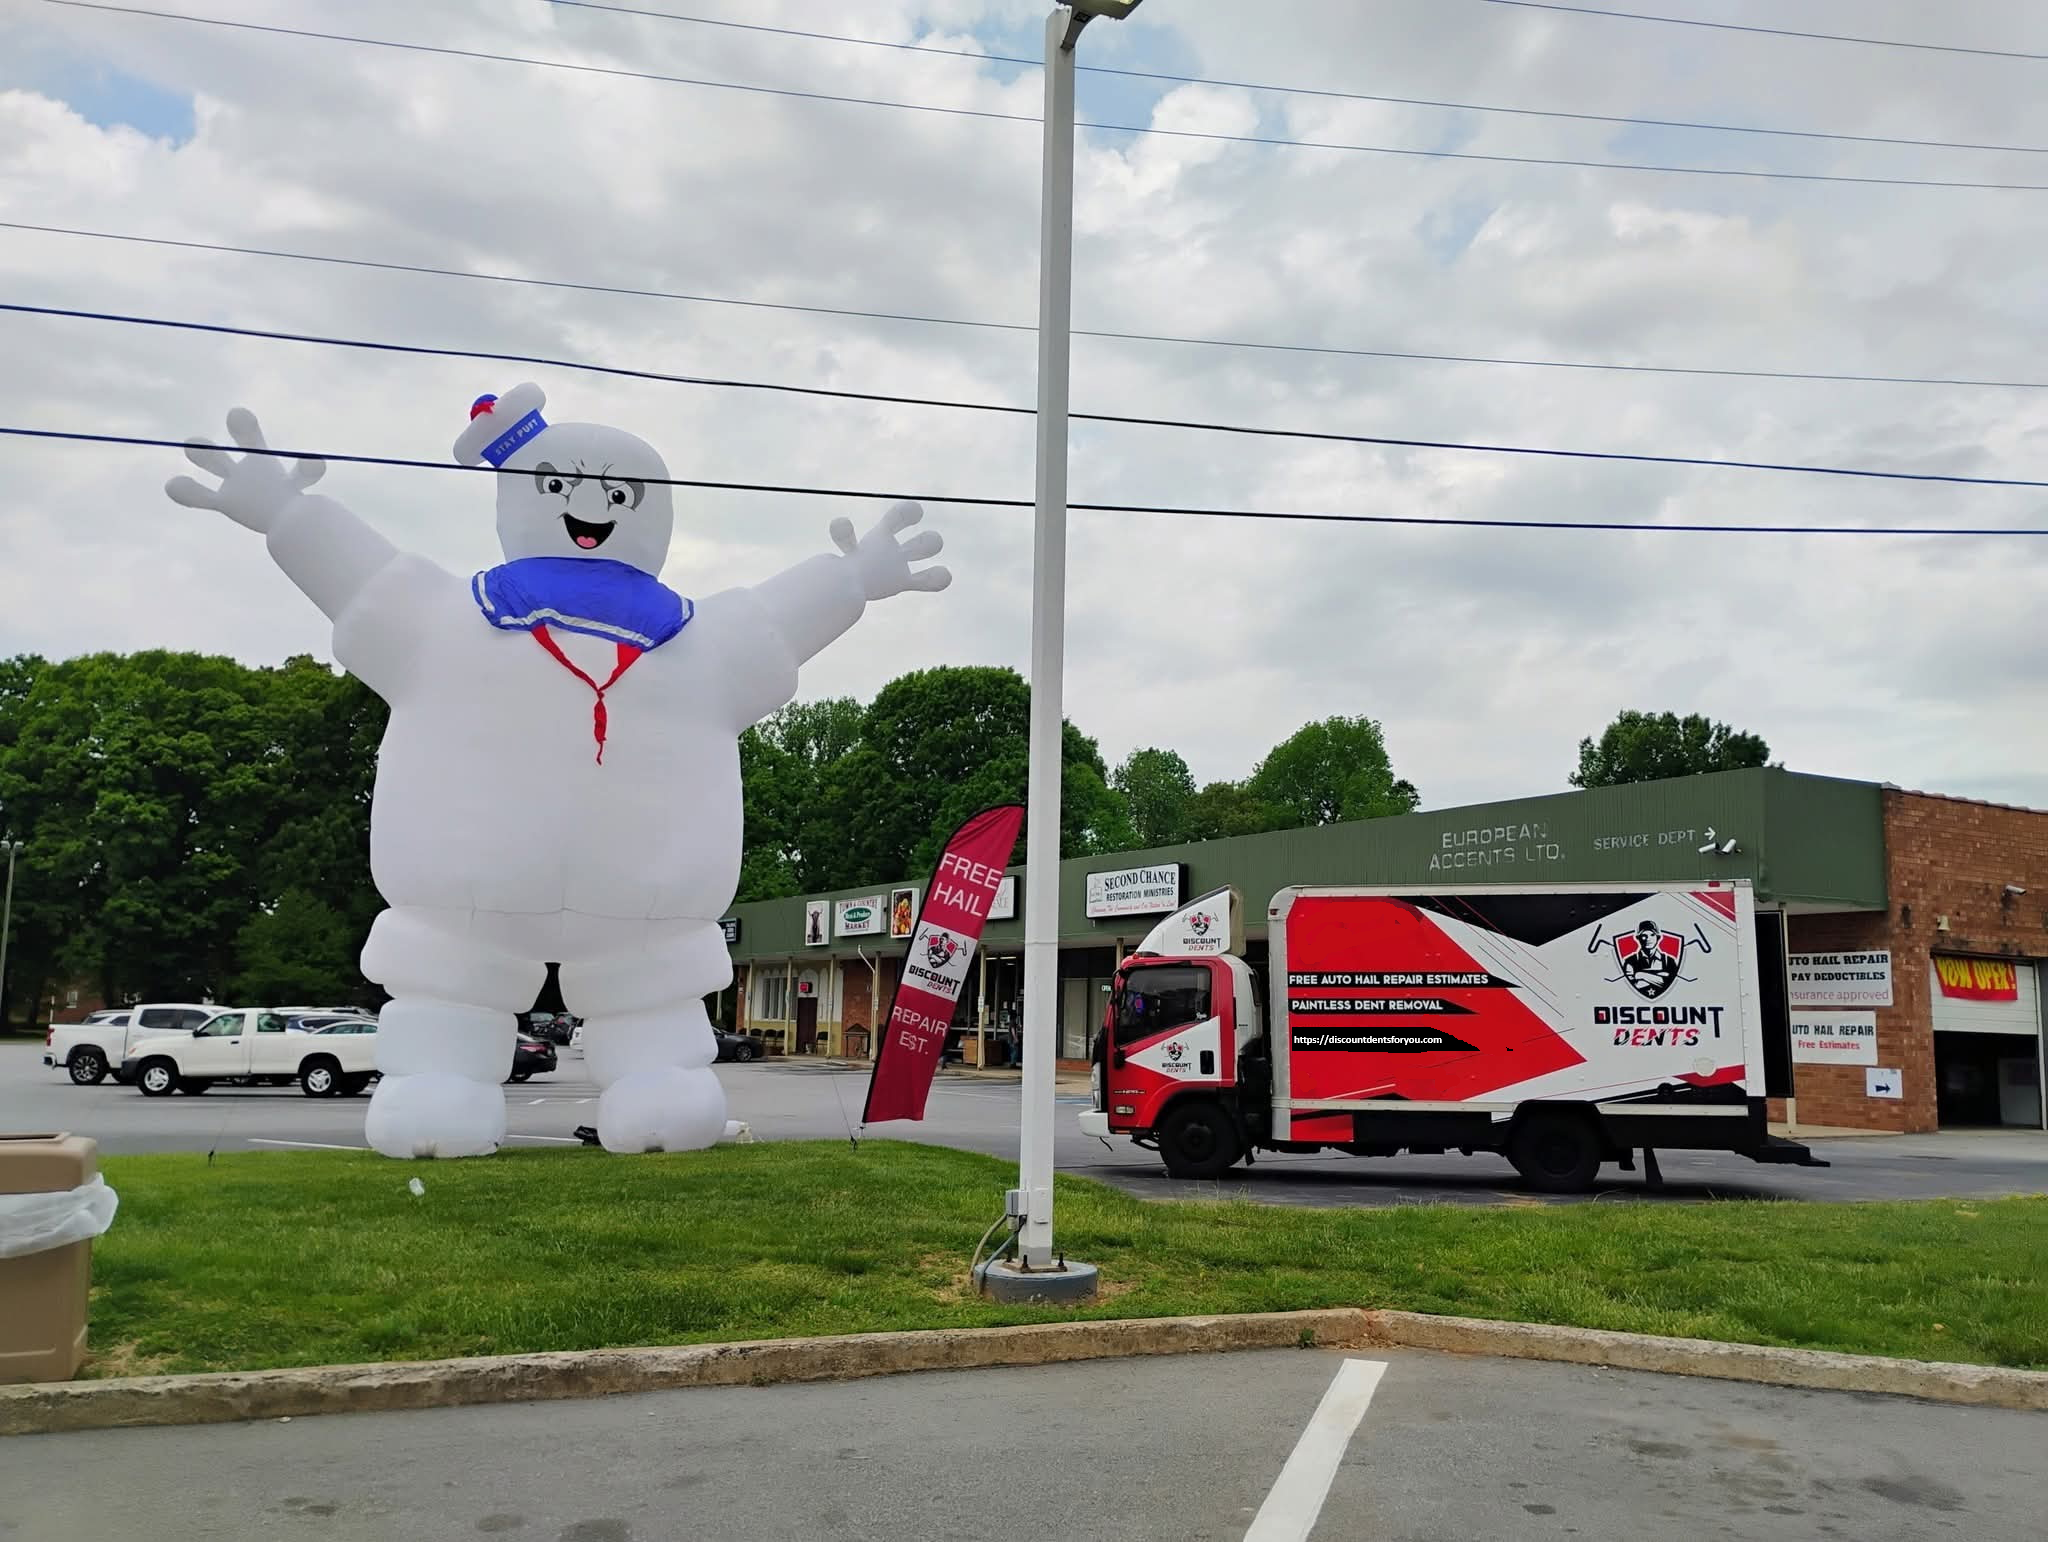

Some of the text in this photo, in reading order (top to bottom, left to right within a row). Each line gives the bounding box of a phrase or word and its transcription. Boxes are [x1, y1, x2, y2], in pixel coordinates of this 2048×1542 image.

[495, 418, 538, 456] STAY PUFT
[1442, 823, 1547, 849] EUROPEAN
[1593, 829, 1696, 850] SERVICE DEPT
[1429, 843, 1566, 871] ACCENTS LTD.
[938, 852, 1003, 891] FREE
[1104, 869, 1176, 891] SECOND CHANCE
[933, 882, 983, 917] HAIL
[1106, 887, 1174, 902] RESTORATION MINISTRIES
[1183, 938, 1222, 949] DISCOUNT
[1788, 953, 1889, 966] UTO HAIL REPAIR
[908, 964, 961, 996] DISCOUNT
[1289, 974, 1489, 985] FREE AUTO HAIL REPAIR ESTIMATES
[1791, 971, 1886, 982] PAY DEDUCTIBLES
[926, 981, 952, 995] DENTS
[1790, 989, 1889, 1004] nsurance approved
[1291, 1000, 1444, 1011] PAINTLESS DENT REMOVAL
[891, 1006, 948, 1037] REPAIR
[1594, 1006, 1724, 1038] DISCOUNT
[1791, 1024, 1875, 1036] UTO HAIL REPAIR
[899, 1031, 929, 1056] EST.
[1293, 1034, 1443, 1046] https://discountdentsforyou.com
[1613, 1028, 1700, 1047] DENTS
[1797, 1040, 1861, 1050] Free Estimates
[1161, 1062, 1192, 1071] DISCOUNT
